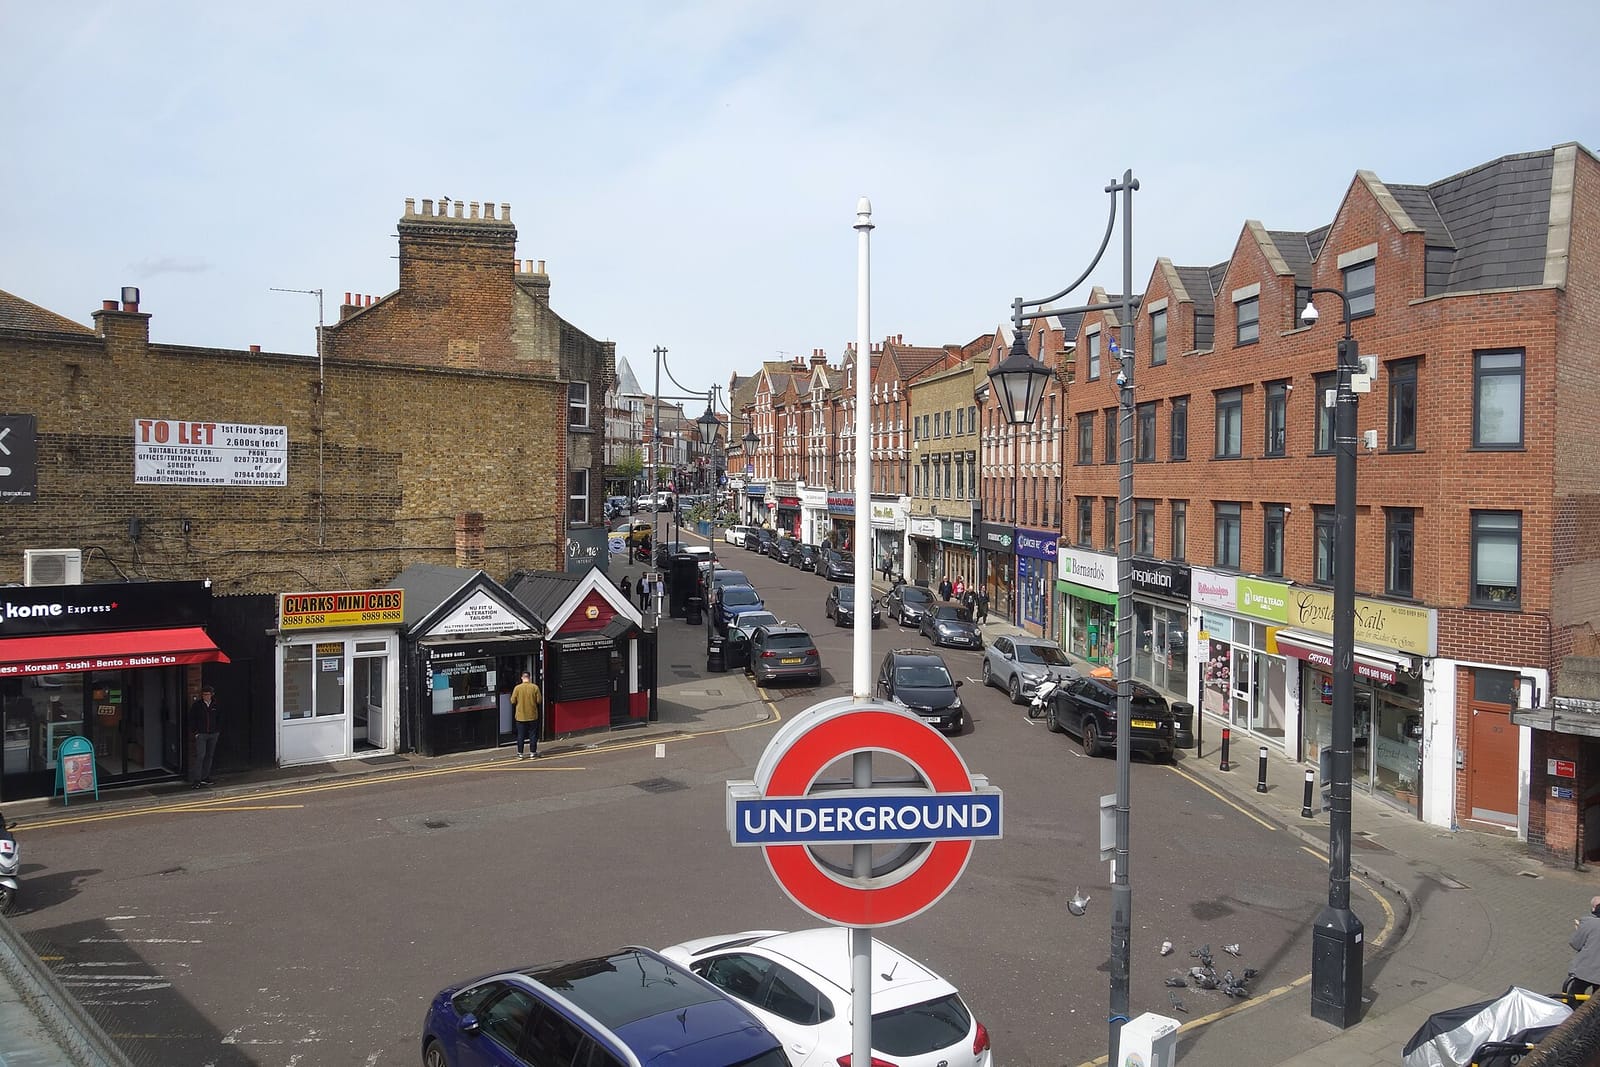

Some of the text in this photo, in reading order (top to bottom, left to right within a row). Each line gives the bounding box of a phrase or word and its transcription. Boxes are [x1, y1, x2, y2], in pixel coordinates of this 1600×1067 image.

[138, 421, 217, 445] TO LET
[221, 425, 284, 436] 1st Floor Space
[262, 440, 279, 448] feet
[166, 469, 198, 477] enquiries
[1072, 558, 1105, 581] Barnardo's
[6, 602, 111, 618] kome Express
[285, 593, 400, 613] CLARKS MINI CABS
[361, 611, 381, 621] 8989
[1297, 591, 1386, 631] Crysta Nails
[282, 615, 303, 626] 8989
[24, 663, 59, 672] Korean
[65, 661, 90, 670] Sushi
[129, 657, 160, 665] Bubble
[1308, 652, 1332, 666] CRYSTAL
[744, 803, 992, 834] UNDERGROUND
[4, 842, 12, 850] L
